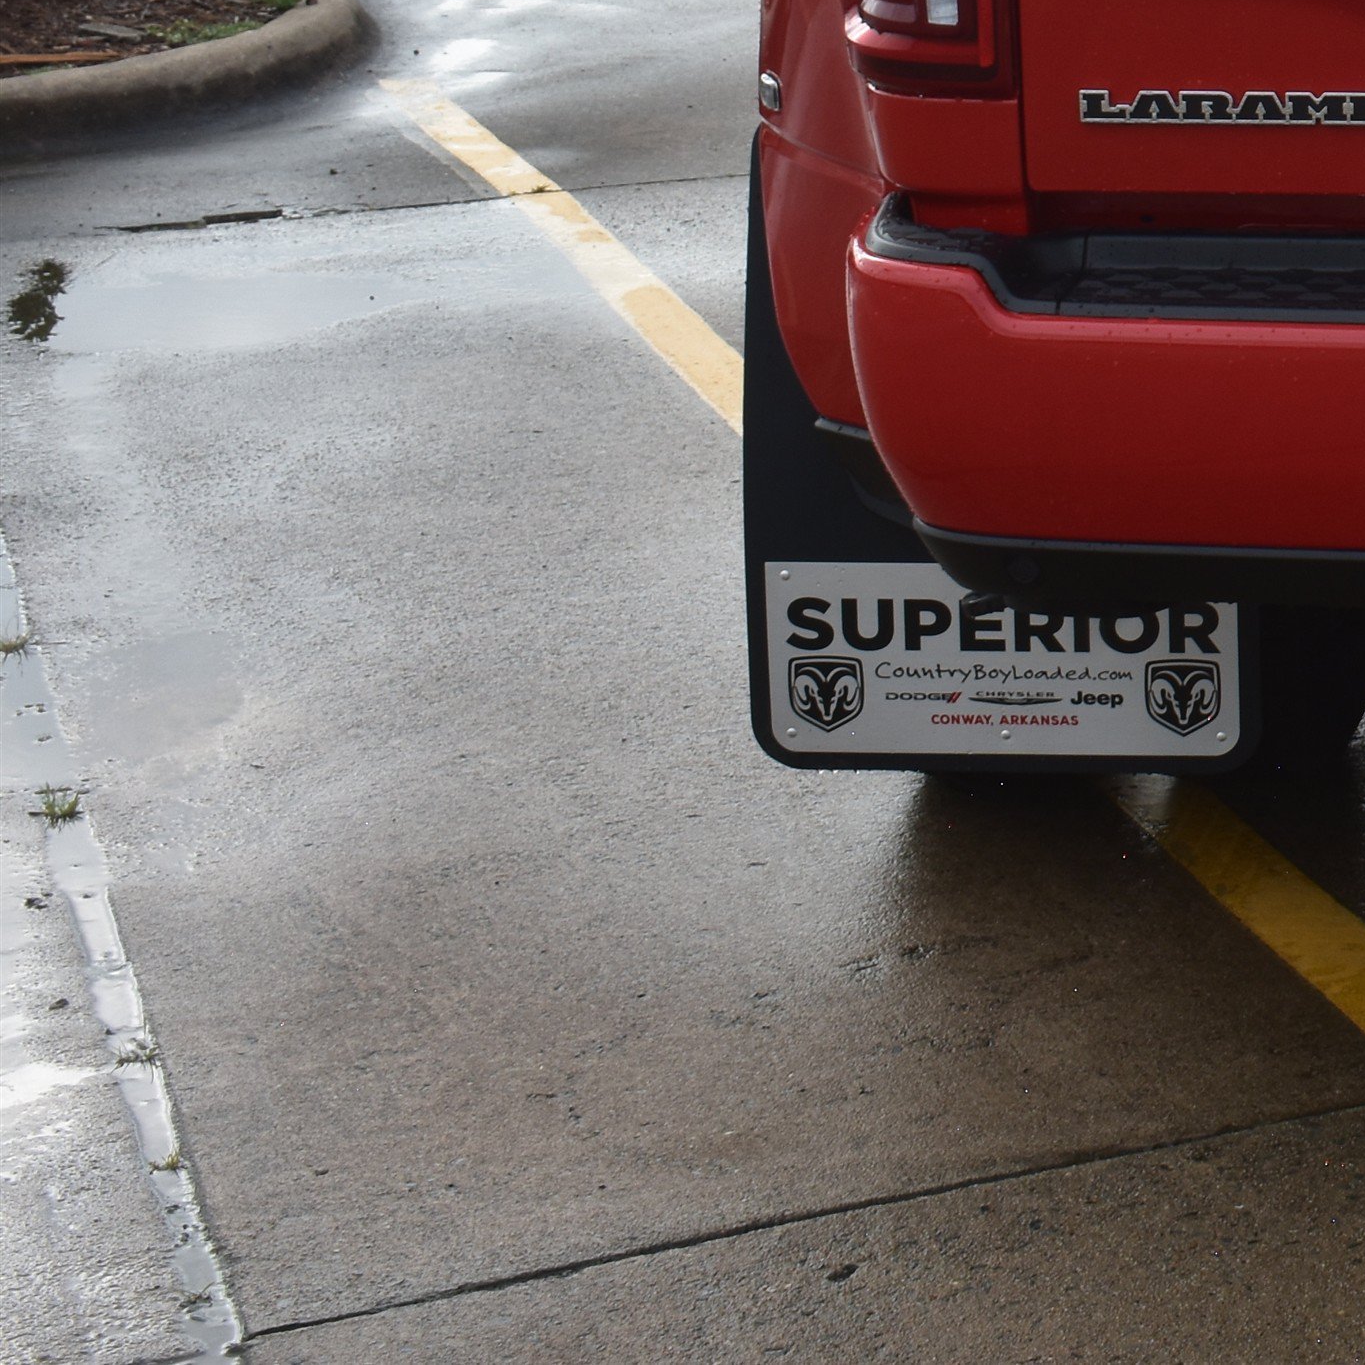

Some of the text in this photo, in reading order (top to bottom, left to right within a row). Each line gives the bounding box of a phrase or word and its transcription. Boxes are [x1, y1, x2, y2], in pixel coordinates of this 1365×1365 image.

[875, 661, 1133, 684] CountryBoyLoaded.com
[885, 691, 951, 701] DODGE
[1070, 691, 1124, 708] Jeep
[931, 714, 1079, 726] CONWAY, ARKANSAS
